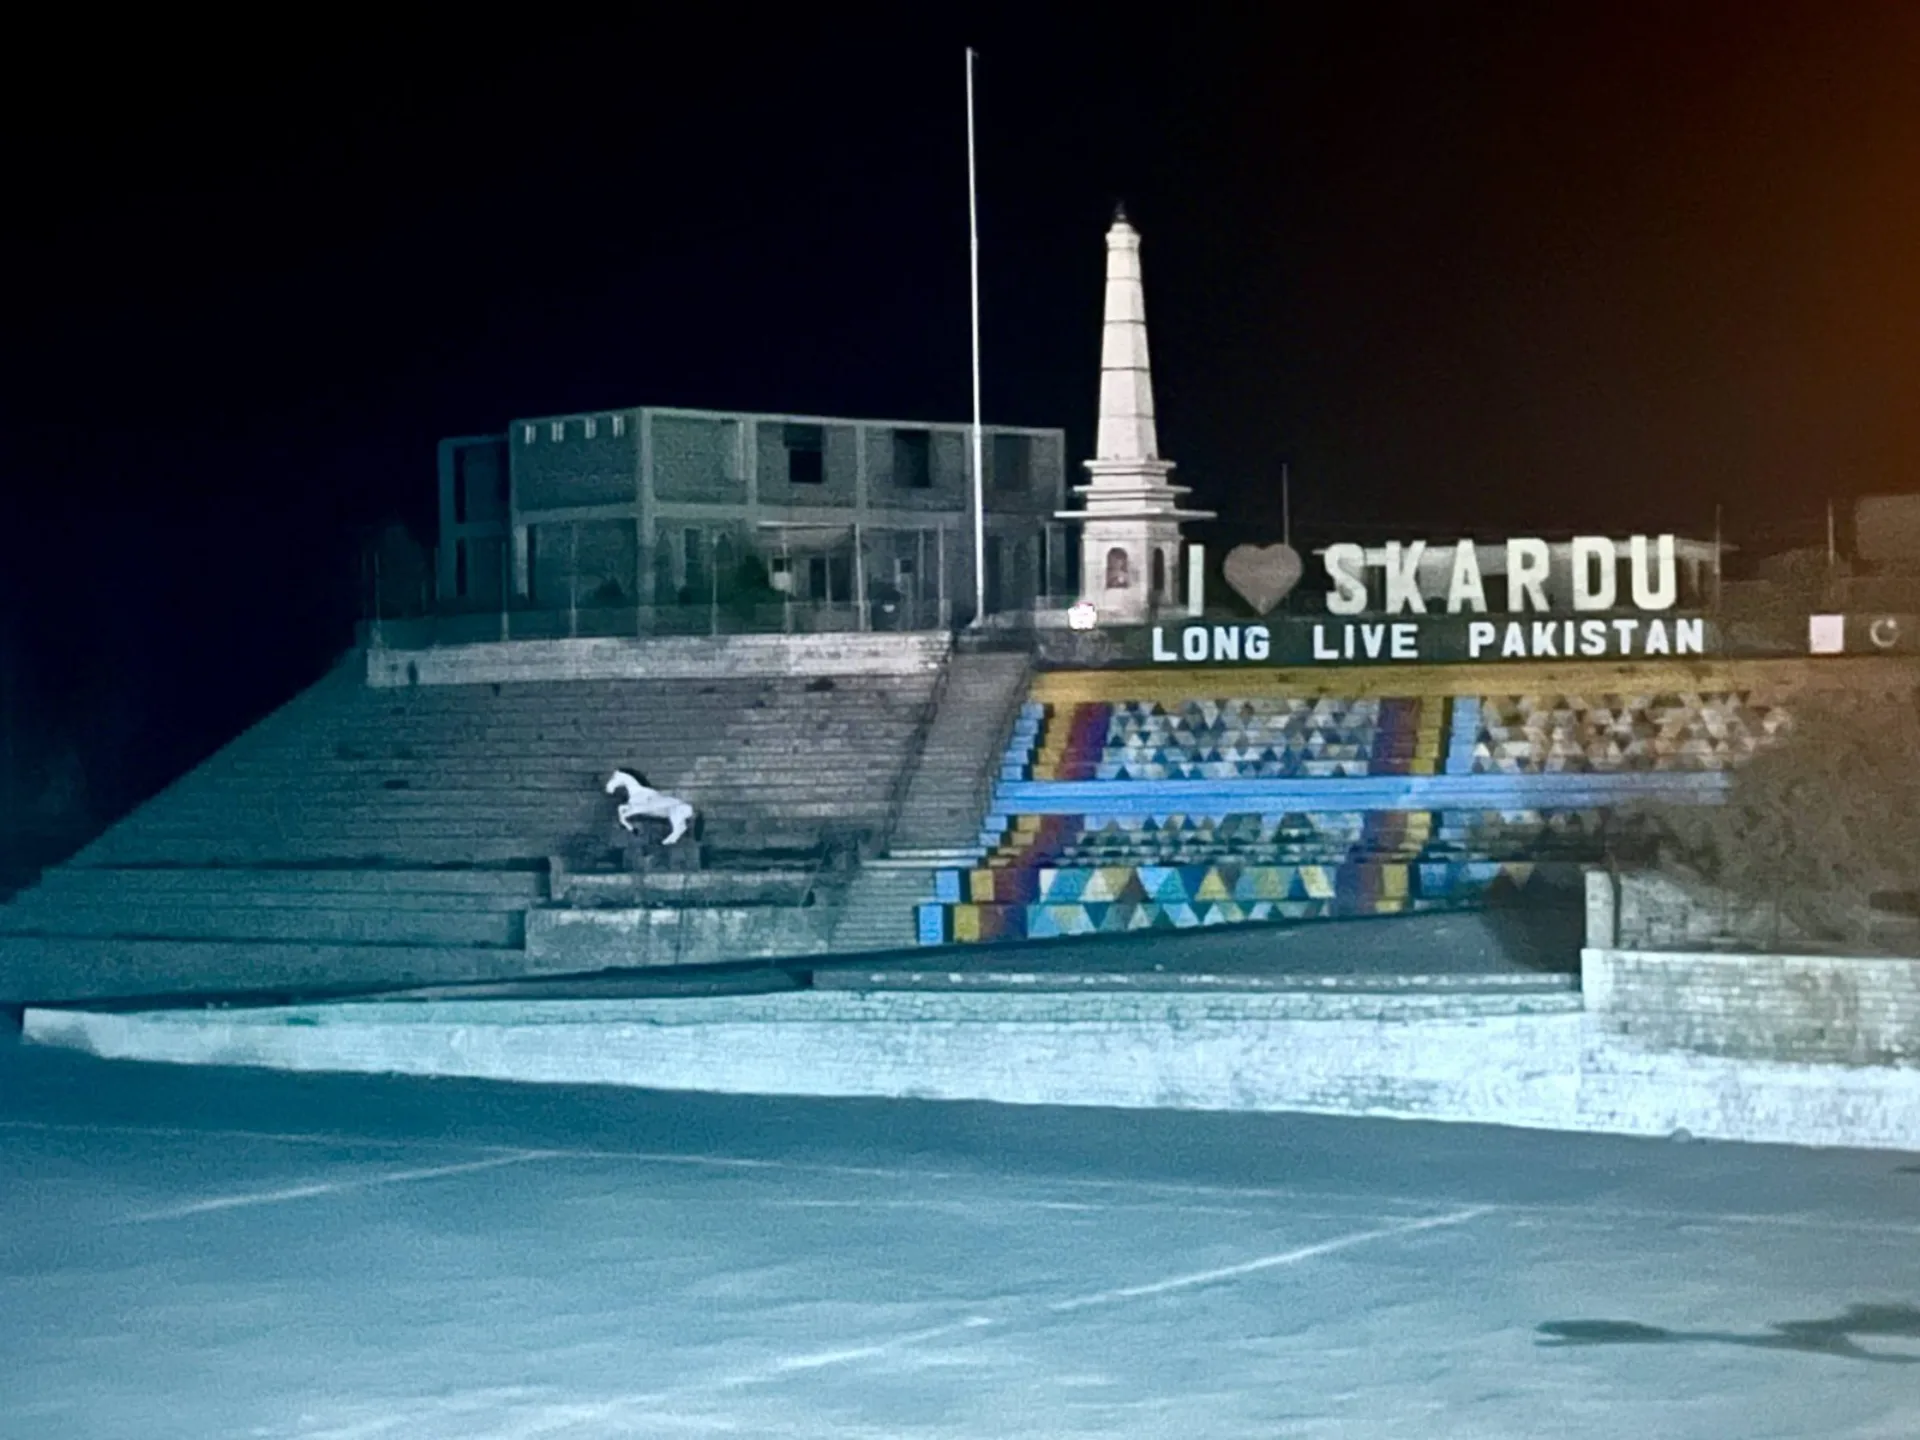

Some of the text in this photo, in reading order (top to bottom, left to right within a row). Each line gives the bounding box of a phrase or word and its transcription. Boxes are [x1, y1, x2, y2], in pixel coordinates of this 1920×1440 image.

[1188, 534, 1678, 617] I SKARDU
[1152, 618, 1704, 662] LONG LIVE PAKISTAN
